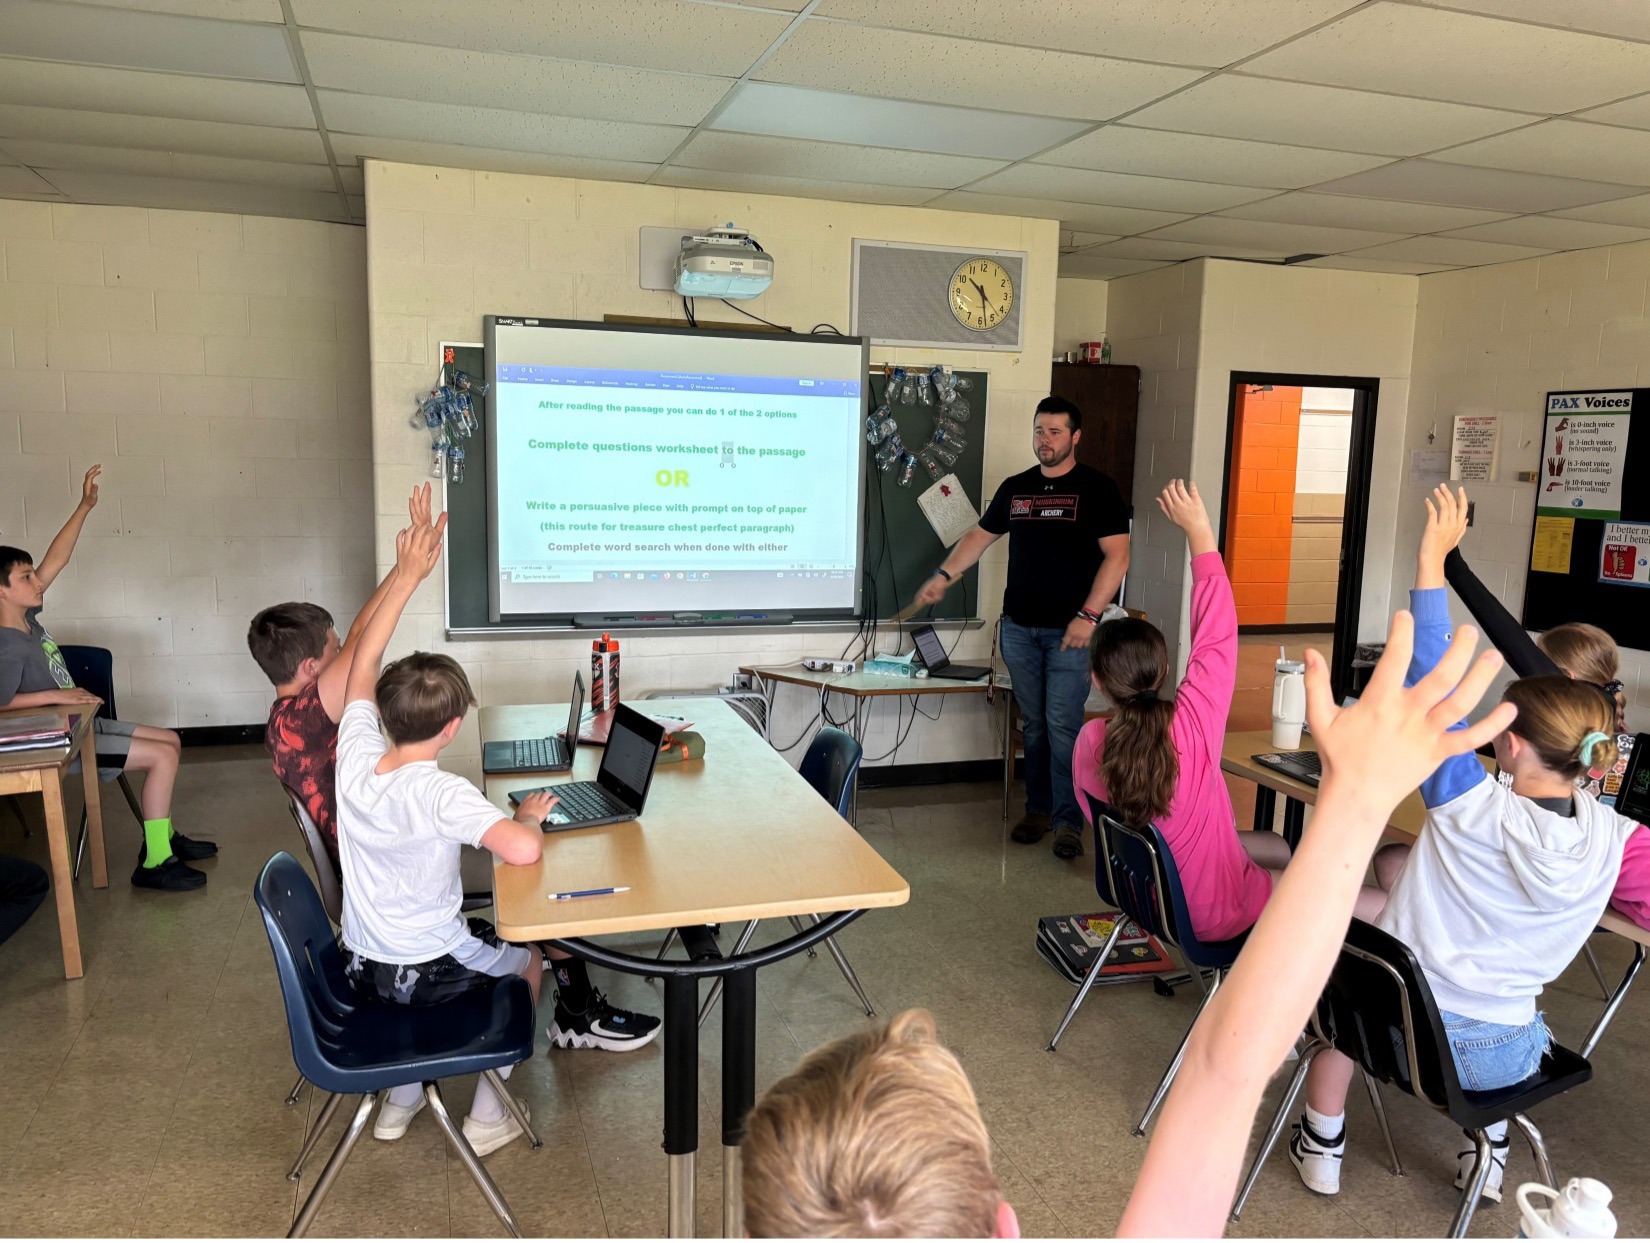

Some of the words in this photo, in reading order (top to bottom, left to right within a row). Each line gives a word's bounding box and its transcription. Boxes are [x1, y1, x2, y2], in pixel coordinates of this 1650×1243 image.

[969, 265, 976, 275] 11
[980, 263, 988, 273] 12
[994, 268, 997, 278] 1
[959, 274, 967, 284] 10
[1000, 278, 1006, 288] 2
[956, 287, 961, 297] 9
[1003, 292, 1008, 301] 3
[999, 305, 1004, 314] 4
[966, 311, 972, 321] 7
[977, 316, 983, 326] 6
[989, 313, 995, 323] 5
[1550, 397, 1580, 409] PAX
[1584, 396, 1631, 408] Voices
[537, 400, 565, 410] After
[566, 402, 604, 413] reading
[605, 403, 623, 412] the
[624, 405, 665, 415] passage
[666, 407, 684, 416] you
[685, 408, 704, 416] can
[705, 407, 718, 416] do
[719, 407, 725, 416] 1
[727, 408, 738, 417] of
[738, 408, 755, 417] the
[755, 409, 763, 418] 2
[763, 410, 798, 420] options
[527, 438, 589, 452] Complete
[591, 442, 653, 454] questions
[655, 443, 719, 455] worksheet
[722, 445, 734, 455] to
[736, 445, 757, 456] the
[758, 447, 807, 459] passage
[655, 469, 690, 488] OR
[1584, 486, 1608, 494] talking)
[525, 500, 557, 511] Write
[559, 503, 567, 511] a
[569, 502, 631, 513] persuasive
[632, 502, 663, 514] piece
[664, 503, 689, 513] with
[691, 504, 729, 515] prompt
[730, 505, 744, 513] on
[746, 504, 764, 515] top
[765, 504, 777, 513] of
[778, 506, 808, 516] paper
[1040, 509, 1064, 517] ARCHERY
[539, 521, 566, 533] (this
[568, 522, 599, 531] route
[600, 522, 618, 532] for
[619, 522, 666, 532] treasure
[667, 522, 698, 532] chest
[700, 523, 738, 534] perfect
[740, 523, 795, 534] paragraph)
[1610, 524, 1615, 533] I
[1616, 524, 1640, 535] better
[1606, 534, 1622, 542] and
[1624, 534, 1628, 543] I
[547, 542, 602, 553] Complete
[603, 542, 632, 552] word
[634, 542, 671, 552] search
[673, 542, 703, 552] when
[704, 542, 731, 552] done
[732, 542, 756, 552] with
[757, 542, 789, 552] either
